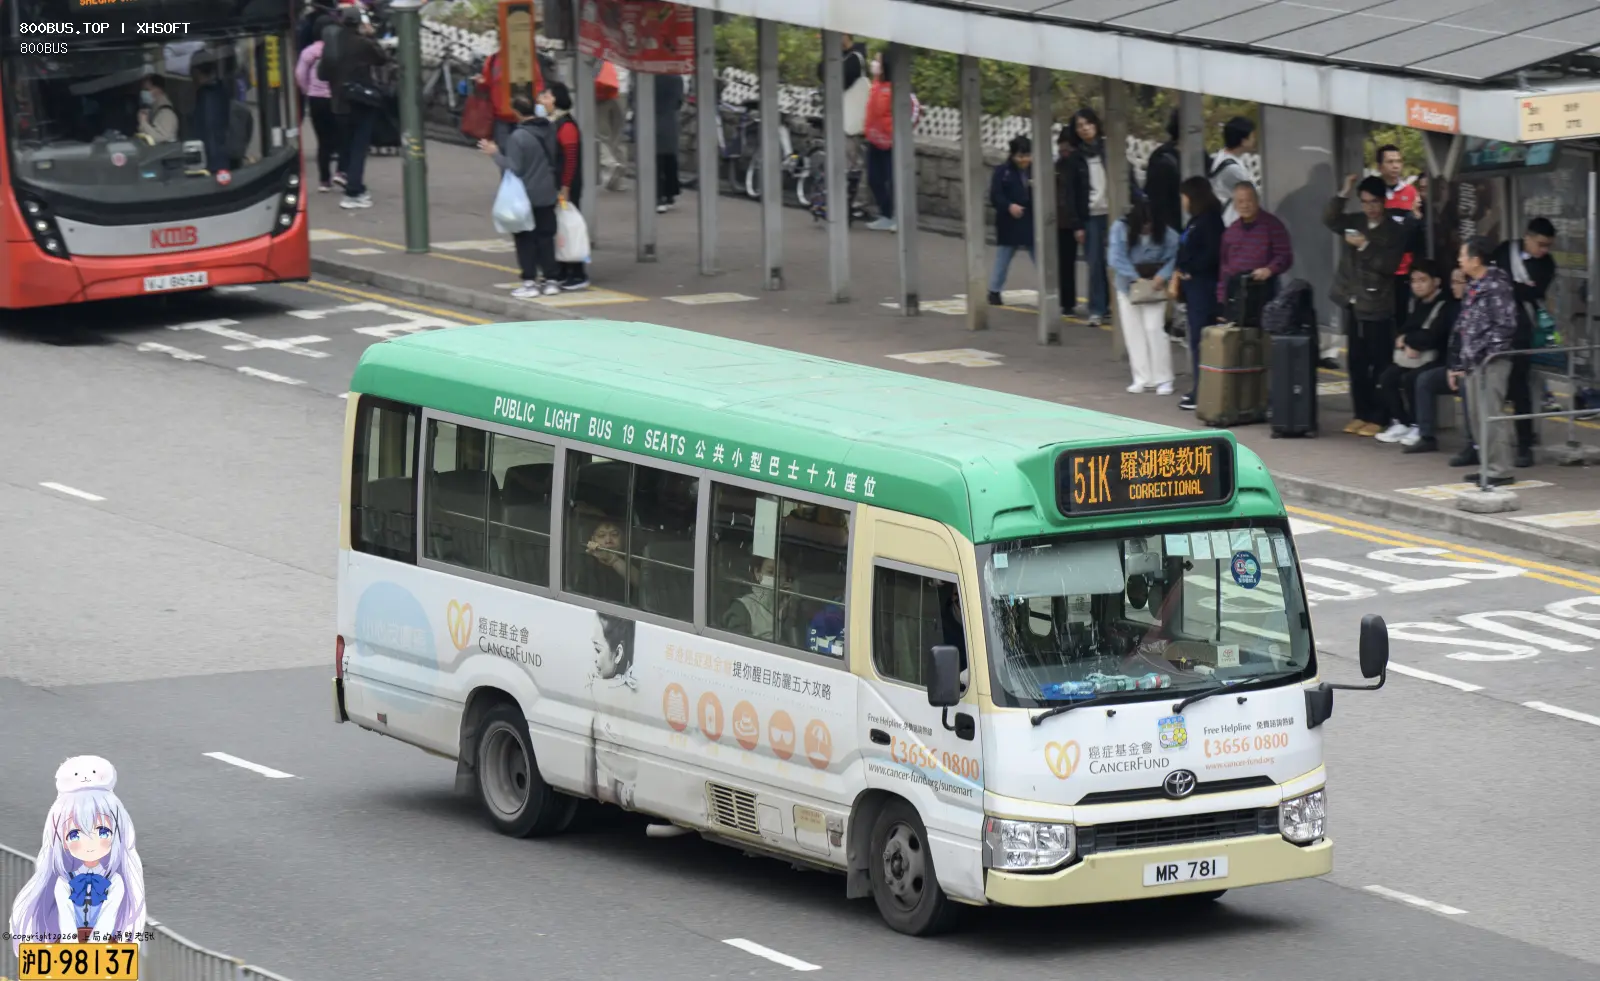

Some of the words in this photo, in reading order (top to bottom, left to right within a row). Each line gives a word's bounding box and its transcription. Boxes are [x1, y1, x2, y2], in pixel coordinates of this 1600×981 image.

[150, 225, 199, 249] KMB
[493, 395, 536, 424] PUBLIC
[543, 407, 580, 434] LIGHT
[588, 417, 613, 440] BUS
[622, 424, 635, 445] 19
[644, 430, 686, 457] SEATS
[694, 439, 878, 499] 公共小型巴士十九座位
[1073, 454, 1112, 505] 51K
[1120, 445, 1213, 481] 羅湖懲教所
[1129, 479, 1204, 501] CORRECTIONAL
[477, 616, 530, 646] 癌症基金會
[867, 712, 879, 724] Free
[1203, 725, 1220, 736] Free
[1220, 722, 1252, 735] Helpline
[1088, 741, 1152, 759] 癌症基金會
[1213, 735, 1250, 757] 3656
[1253, 731, 1289, 752] 0800
[900, 740, 939, 769] 3656
[942, 751, 980, 781] 0800
[1156, 863, 1179, 882] MR
[1187, 859, 1216, 878] 781
